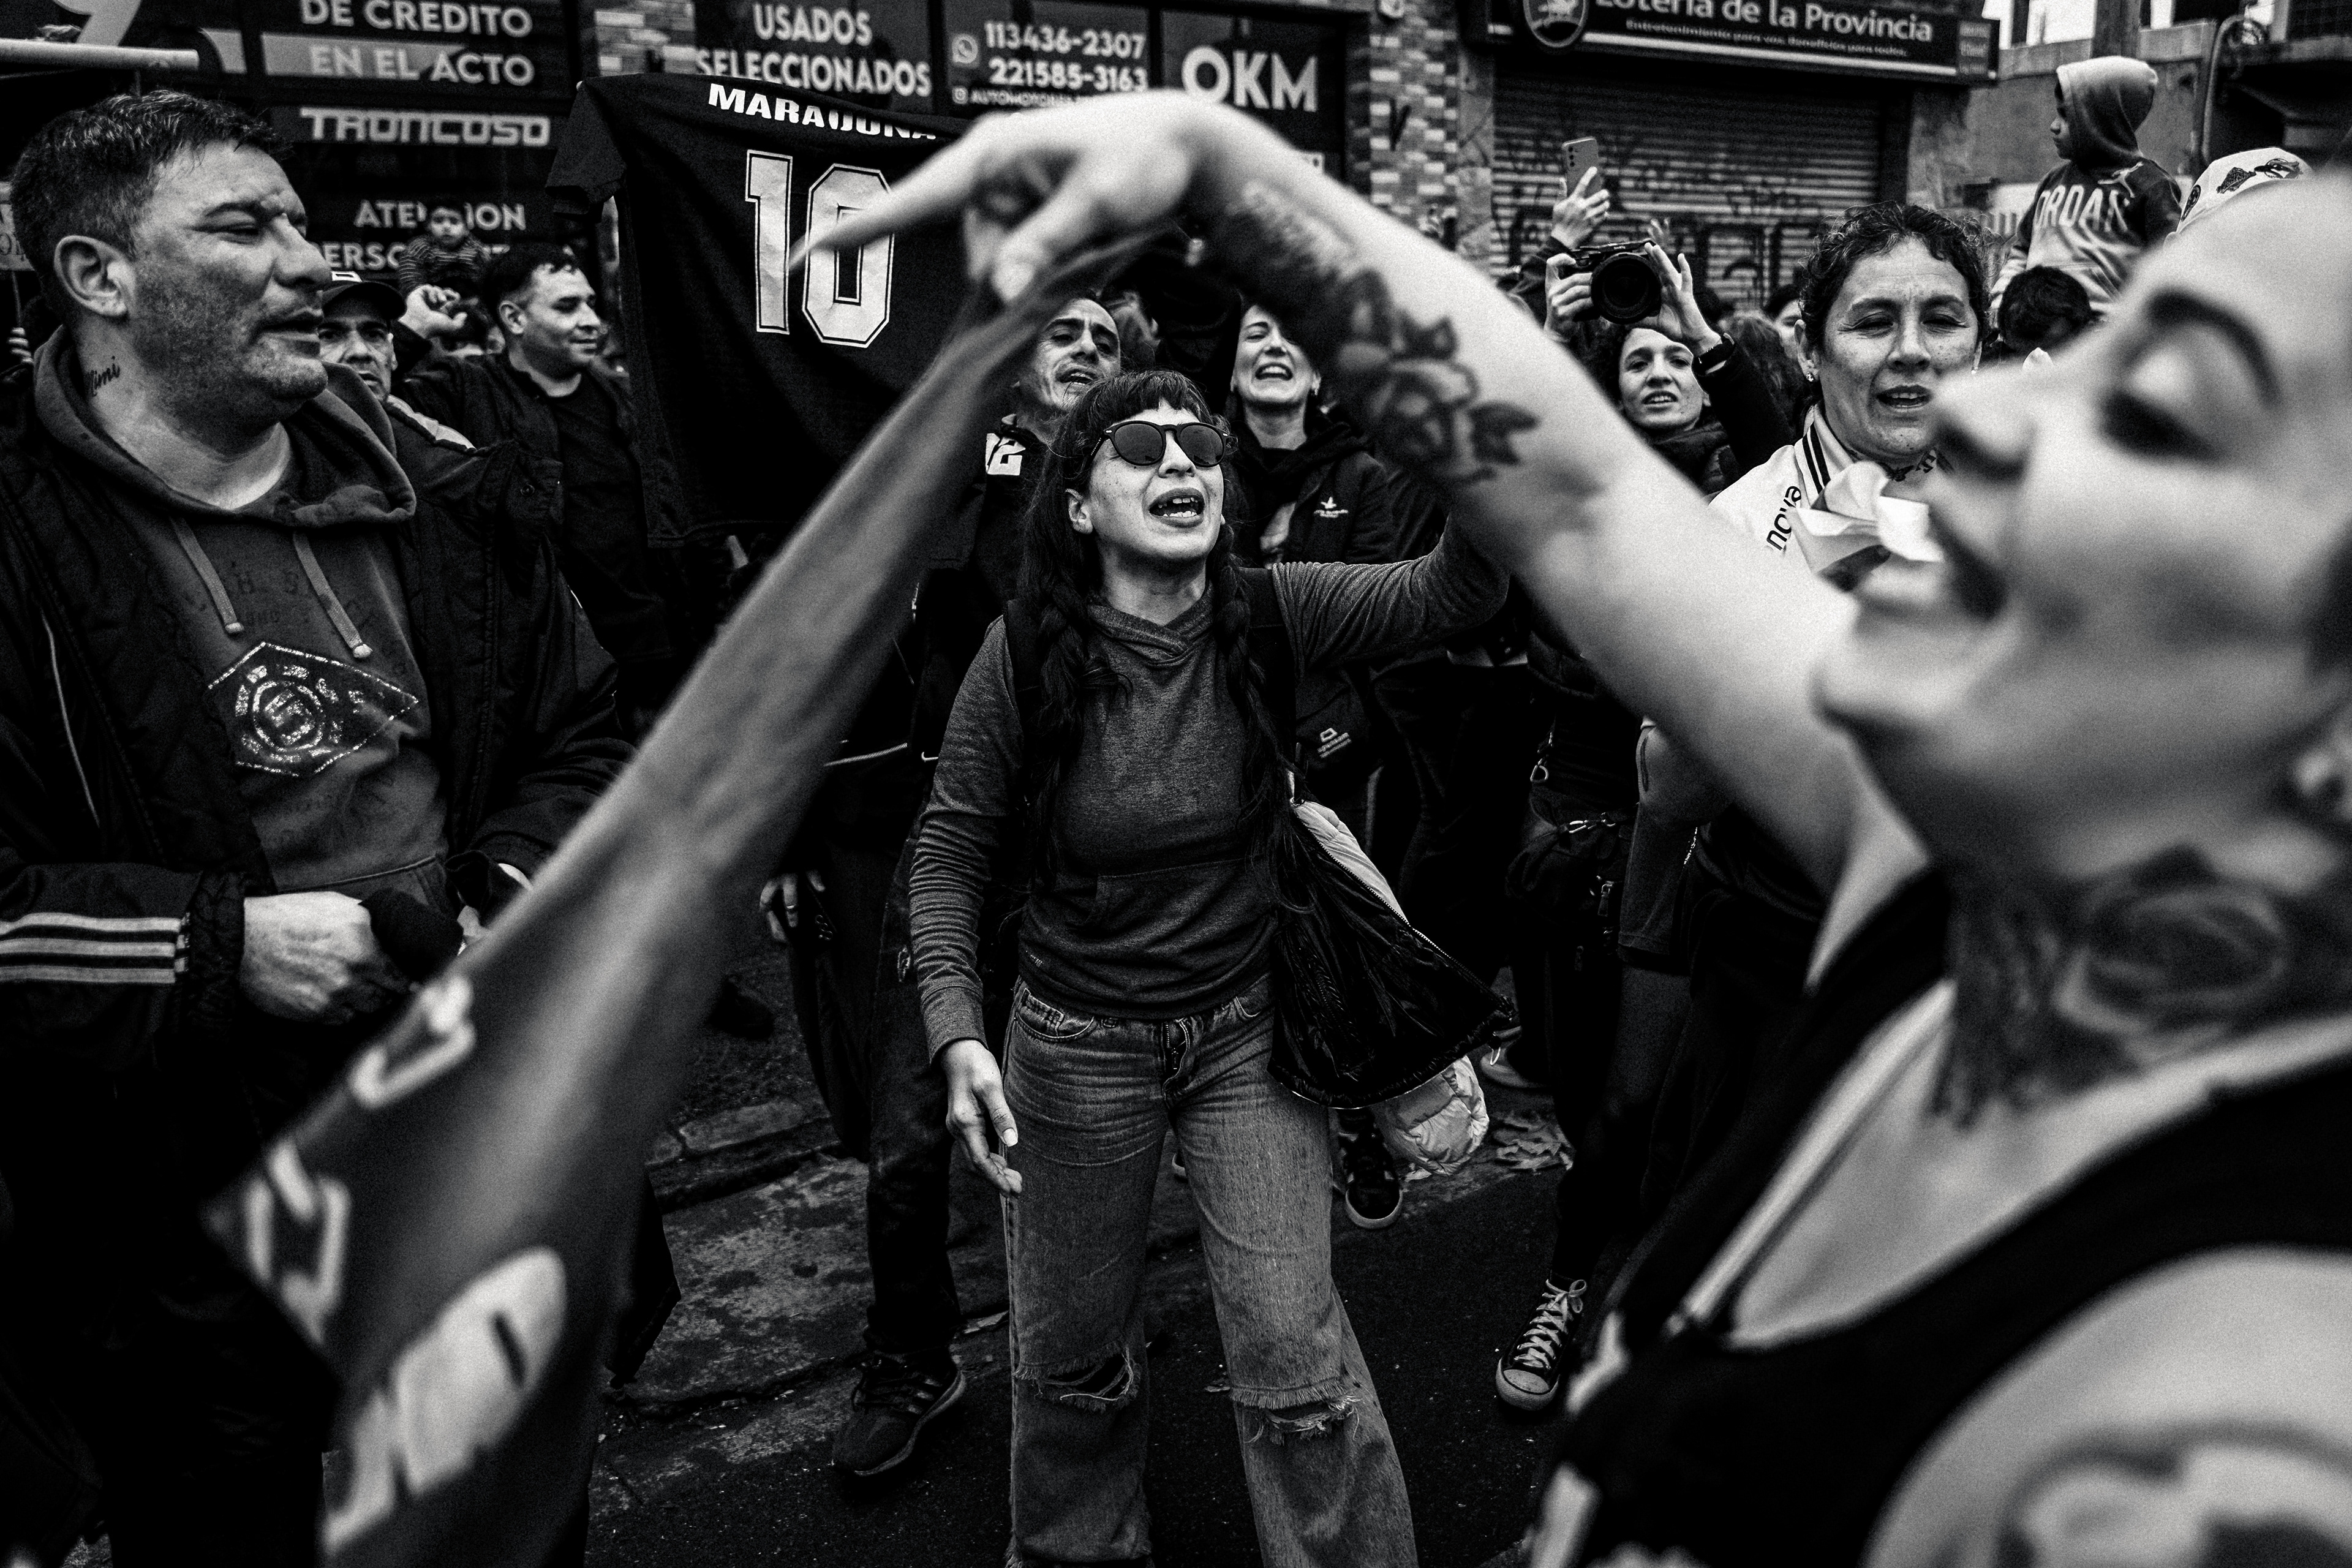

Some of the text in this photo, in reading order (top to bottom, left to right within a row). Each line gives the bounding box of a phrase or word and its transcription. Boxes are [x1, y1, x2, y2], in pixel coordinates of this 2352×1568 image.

[301, 0, 533, 37] DE CREDITO
[753, 2, 873, 46] USADOS
[1722, 0, 1760, 23] de
[1769, 0, 1797, 28] la
[1804, 3, 1933, 42] Provincia
[984, 21, 1146, 59] 113436-2307
[311, 45, 535, 86] EN EL ACTO
[696, 48, 932, 97] SELECCIONADOS
[988, 56, 1148, 92] 221585-3163
[354, 199, 526, 230] ATEION
[2034, 184, 2130, 232] ORDAN
[745, 149, 895, 348] 10
[1766, 486, 1802, 551] nova
